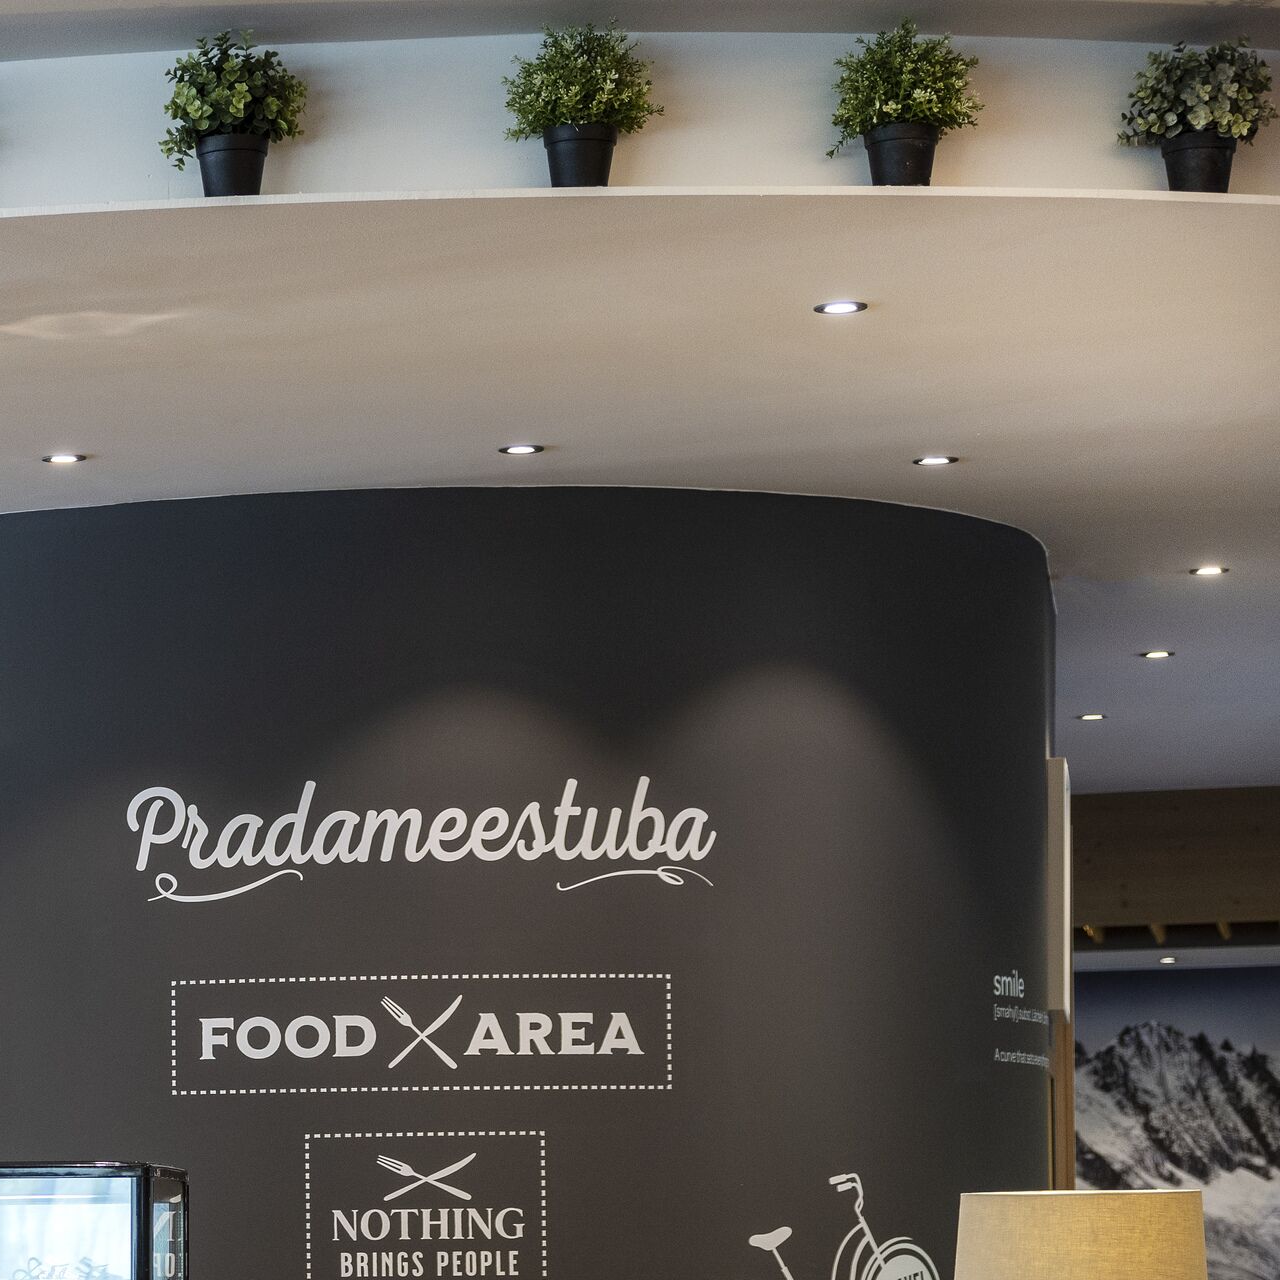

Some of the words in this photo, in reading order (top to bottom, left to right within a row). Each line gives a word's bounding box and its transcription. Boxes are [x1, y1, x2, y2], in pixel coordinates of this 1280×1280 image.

[127, 775, 717, 872] Pradameestuba
[993, 969, 1025, 998] smile
[198, 1014, 377, 1061] FOOD
[463, 1012, 645, 1056] AREA
[331, 1207, 526, 1242] NOTHING
[340, 1251, 424, 1278] BRINGS
[436, 1250, 520, 1277] PEOPLE
